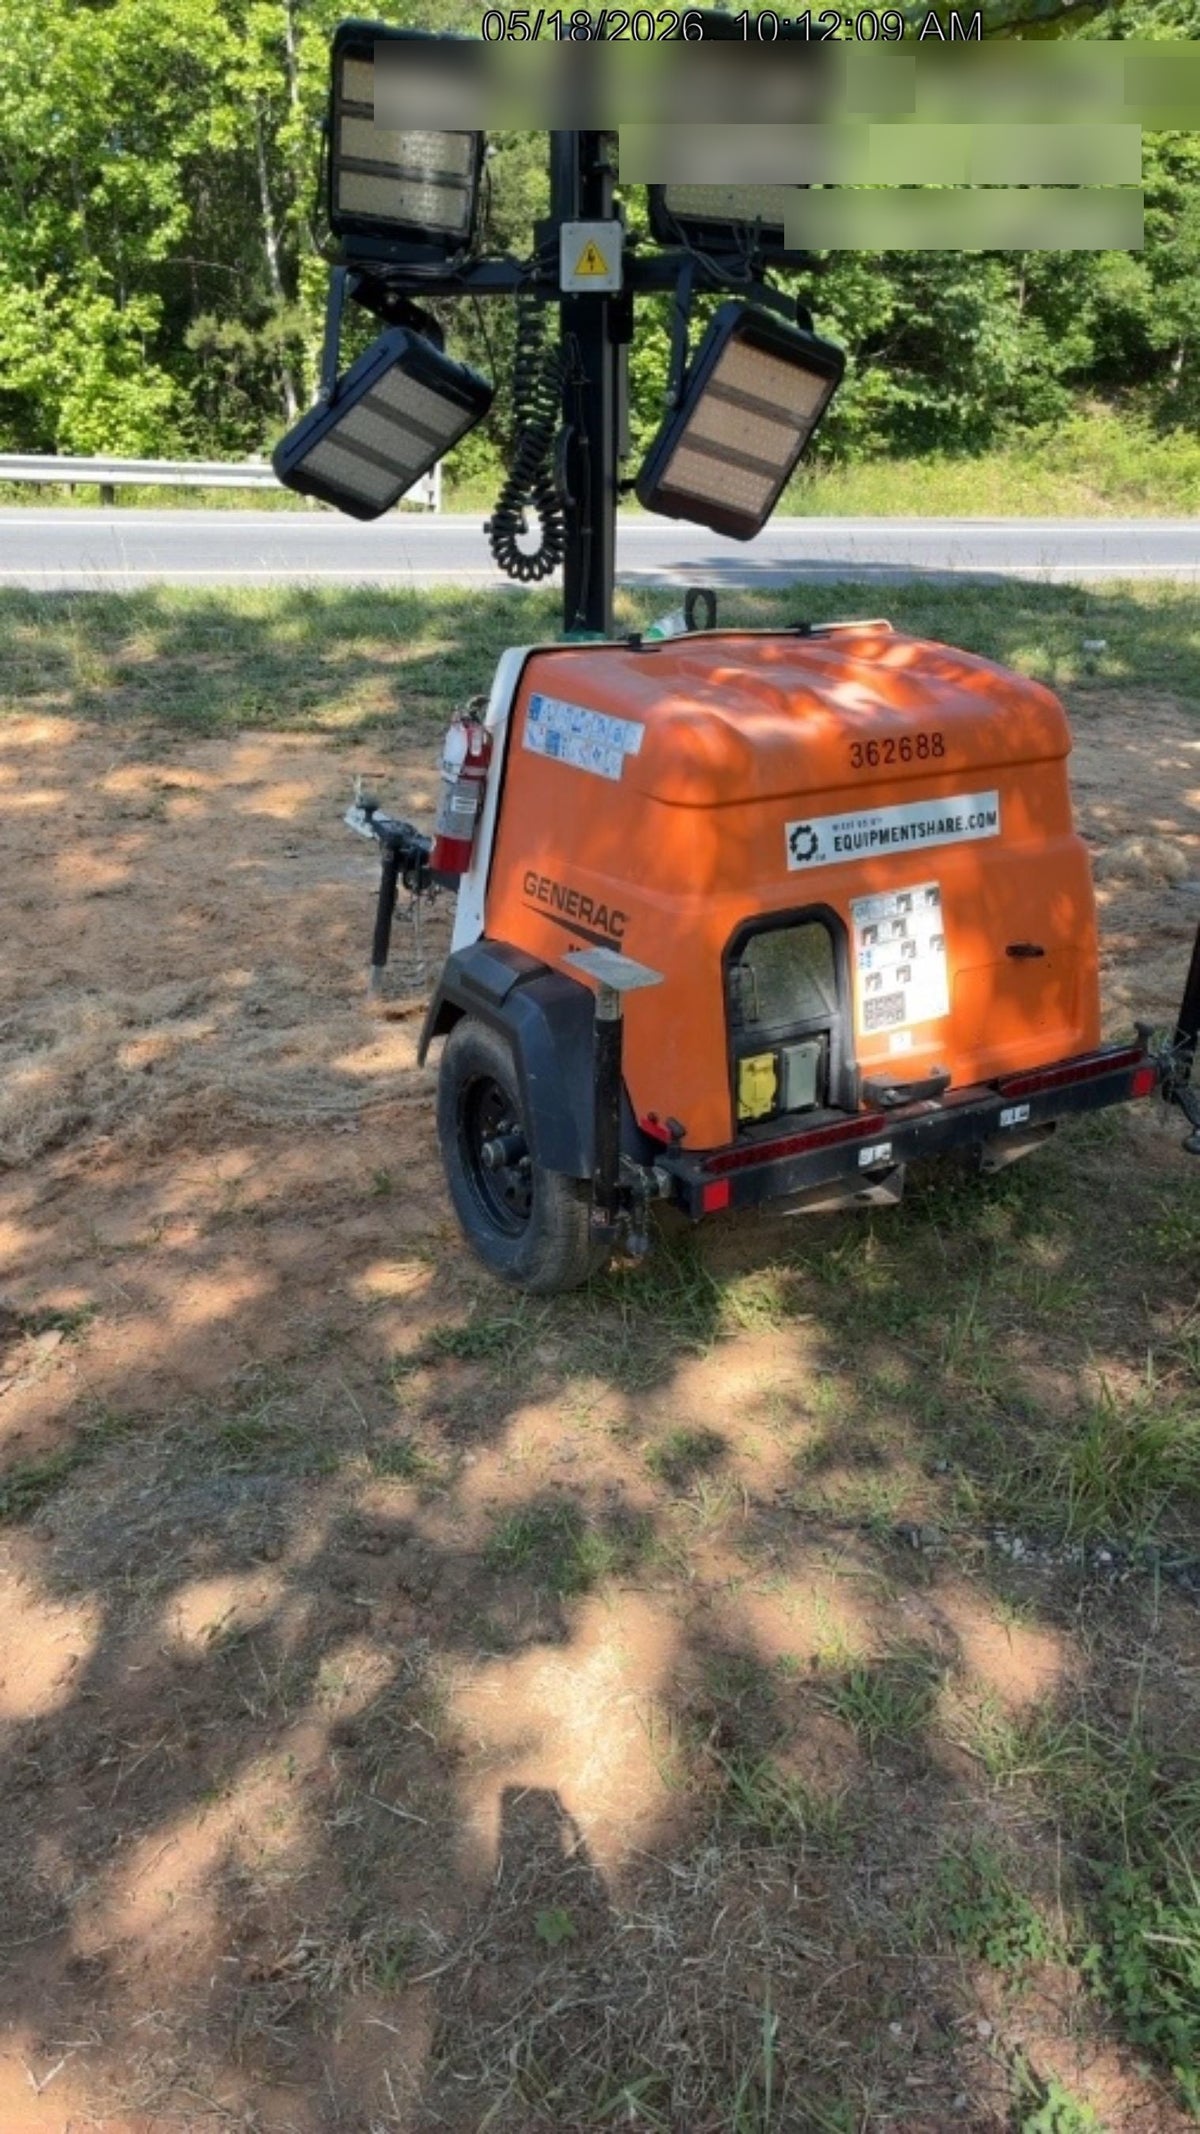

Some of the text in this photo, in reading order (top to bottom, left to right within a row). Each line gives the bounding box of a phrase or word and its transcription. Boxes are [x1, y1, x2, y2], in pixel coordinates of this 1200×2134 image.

[850, 732, 945, 768] 362688
[834, 811, 997, 852] EQUIPMENTSHARE.COM
[523, 870, 626, 937] GENERAC
